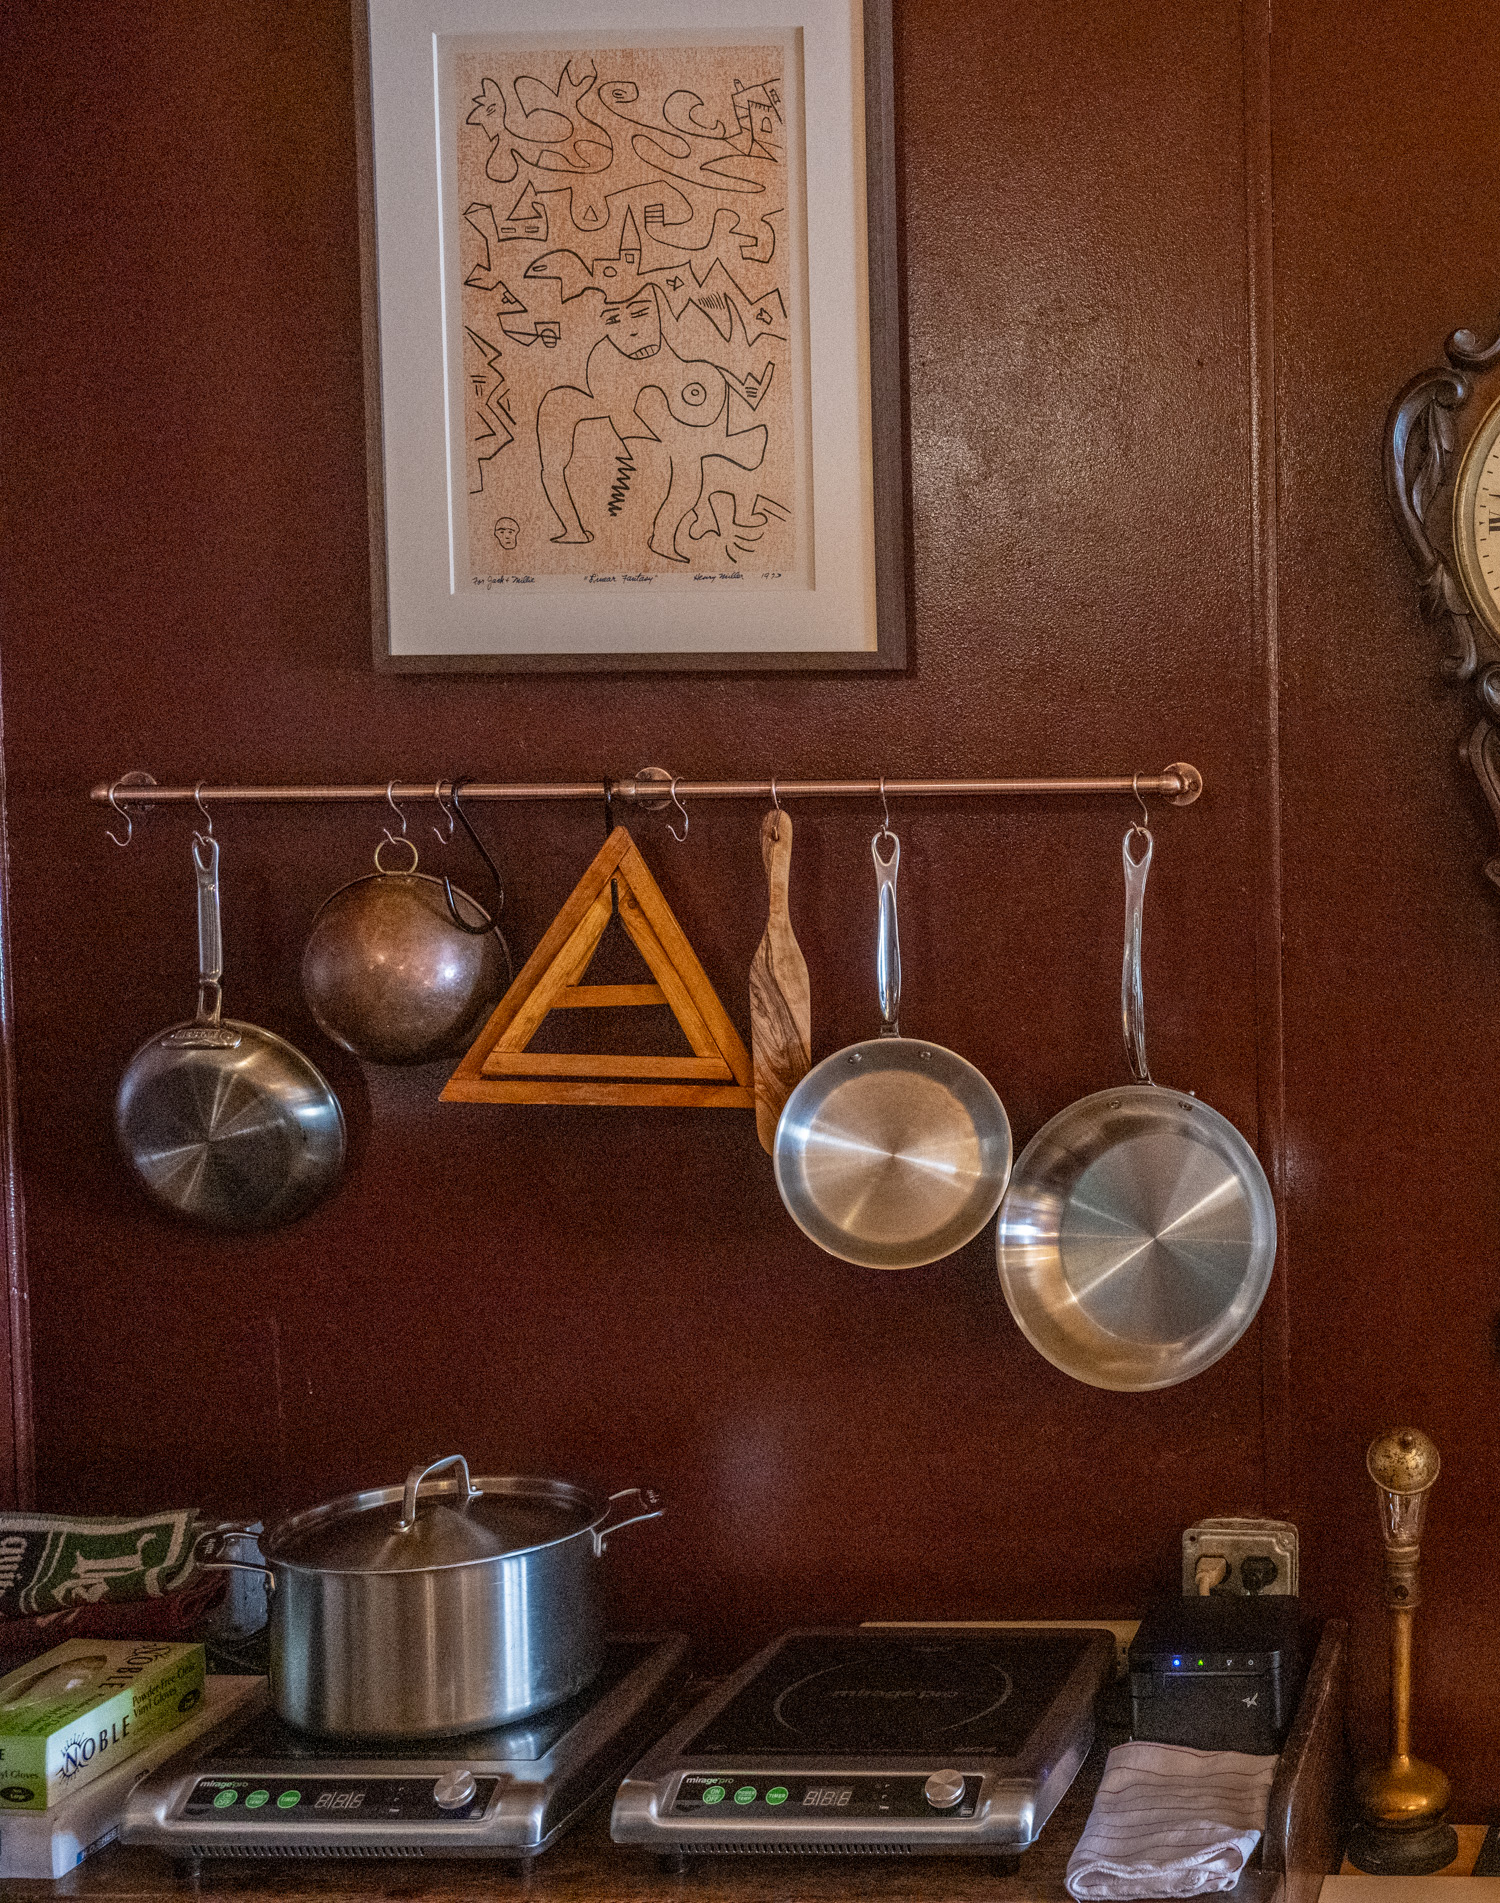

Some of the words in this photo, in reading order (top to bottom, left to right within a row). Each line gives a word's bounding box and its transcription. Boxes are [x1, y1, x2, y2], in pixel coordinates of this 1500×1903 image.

[693, 573, 717, 583] Henry
[98, 1644, 171, 1689] NOBLE
[154, 1687, 178, 1706] Gloves
[56, 1714, 131, 1786] NOBLE
[10, 1770, 39, 1780] Gloves
